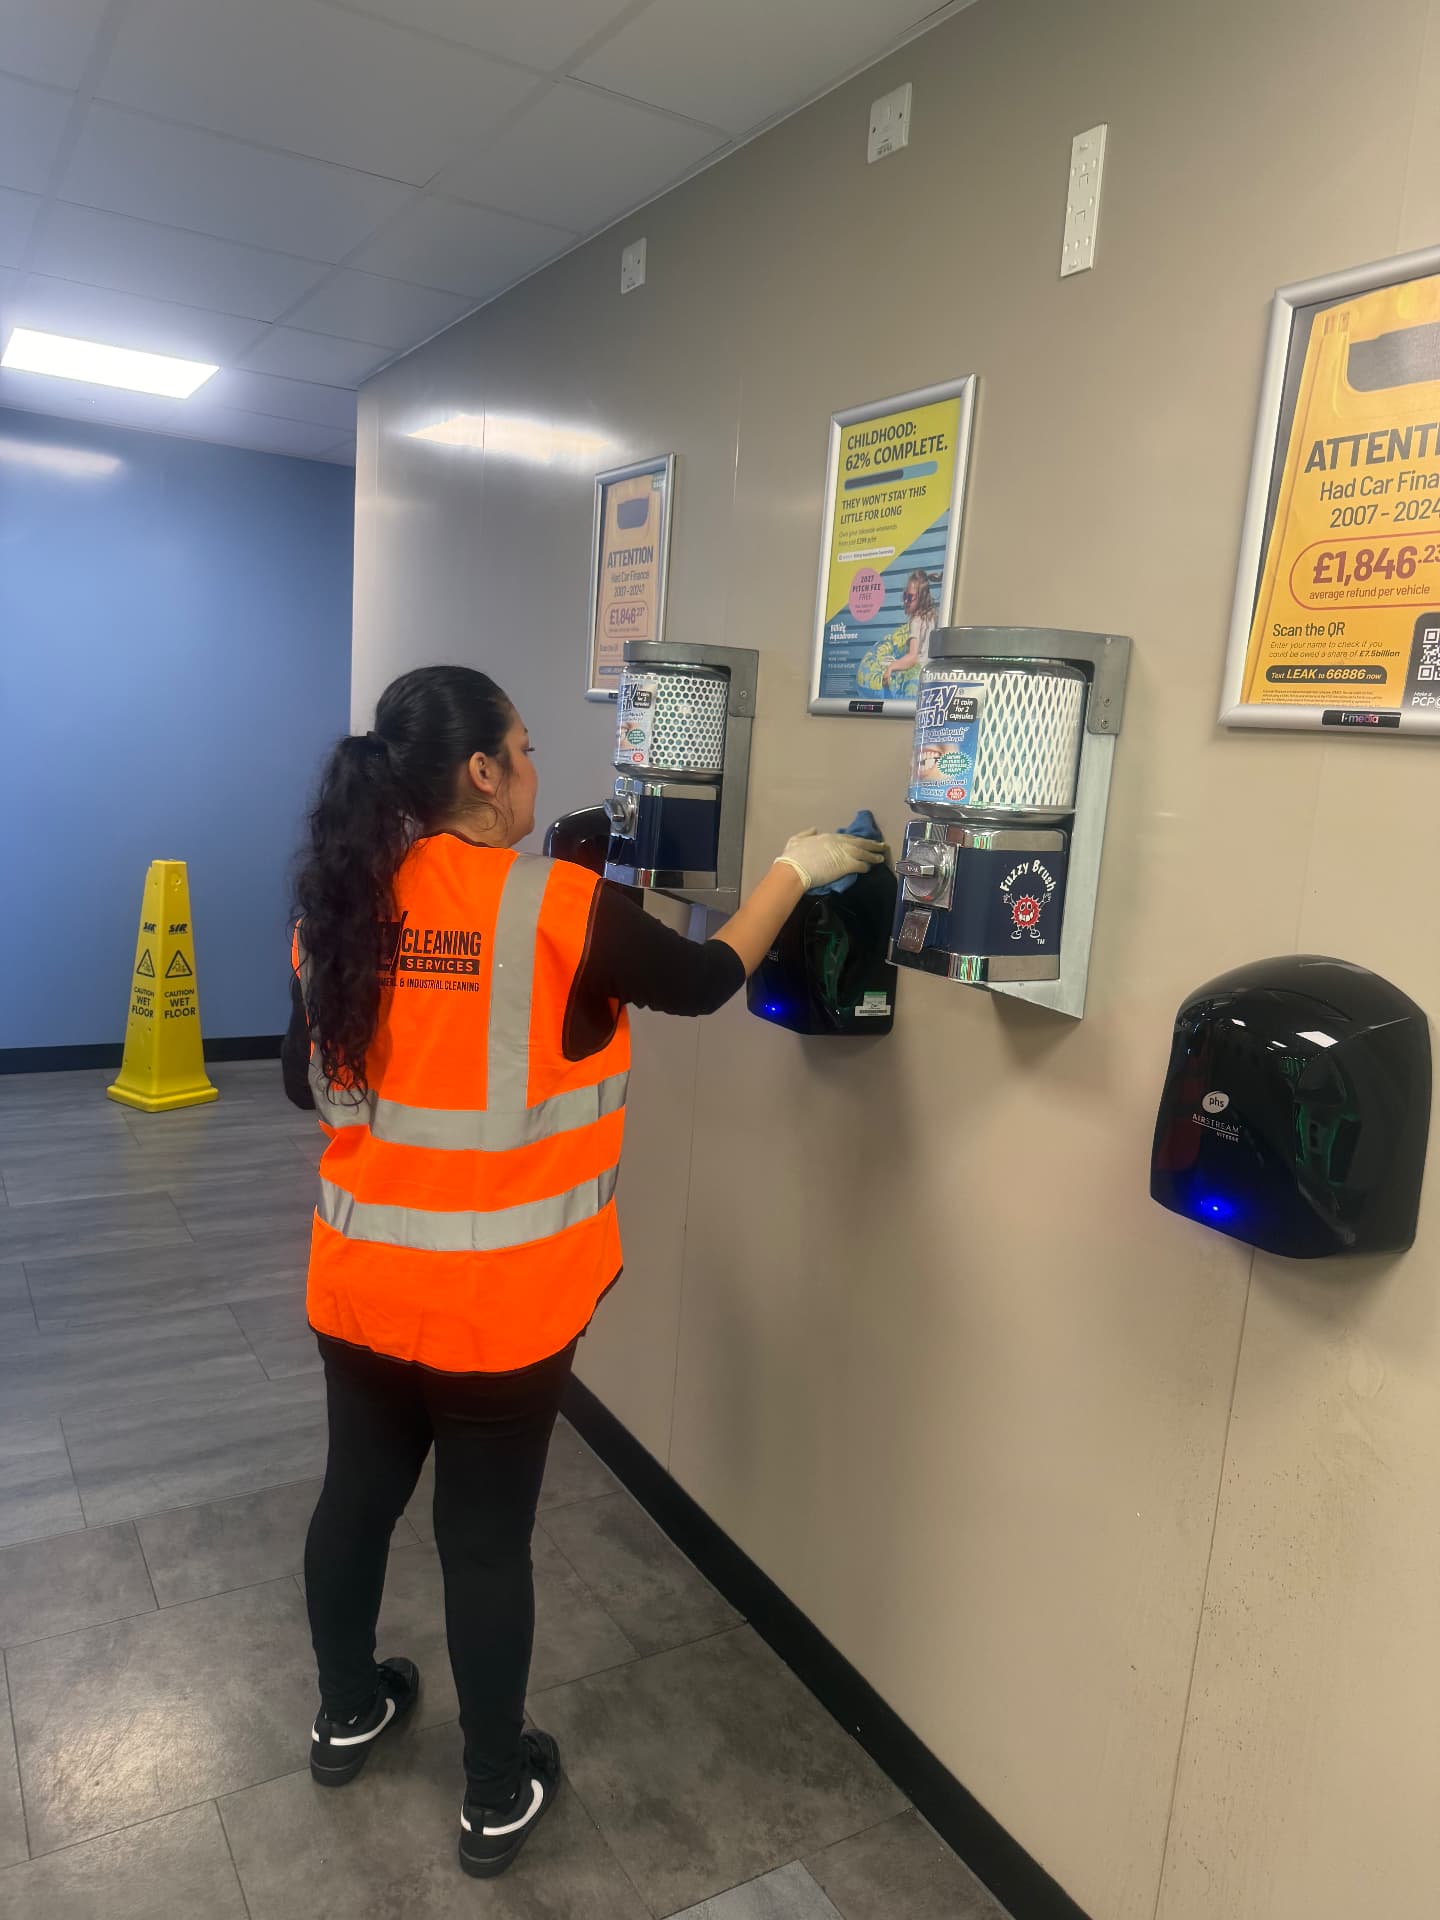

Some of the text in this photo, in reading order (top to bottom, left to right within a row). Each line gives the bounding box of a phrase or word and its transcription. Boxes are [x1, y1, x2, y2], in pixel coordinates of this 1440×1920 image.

[847, 421, 917, 450] CHILDHOOD:
[845, 434, 948, 471] 62% COMPLETE.
[1320, 470, 1440, 501] Had Car Fina
[842, 485, 927, 510] THEY WON'T STAY THIS
[840, 505, 902, 525] LITTLE FOR LONG
[607, 546, 654, 568] ATTENTION
[1309, 584, 1430, 600] average refund per vehicle
[1272, 622, 1346, 637] Scan the QR
[1270, 641, 1287, 649] Enter
[1337, 640, 1359, 648] check
[1368, 641, 1383, 649] you
[1349, 649, 1358, 657] of
[1286, 668, 1319, 679] LEAK
[1326, 668, 1367, 680] 66886
[949, 713, 974, 721] capsules
[1000, 859, 1057, 892] Fuzzy Brush
[401, 928, 482, 956] CLEANING
[406, 958, 474, 972] SERVICES
[134, 986, 155, 997] CAUTION
[407, 978, 443, 990] INDUSTRIAL
[444, 980, 480, 992] CLEANING
[164, 987, 195, 998] CAUTION
[137, 995, 151, 1006] WET
[170, 997, 190, 1007] WET
[131, 1005, 154, 1018] FLOOR
[164, 1007, 196, 1019] FLOOR
[1209, 1096, 1224, 1108] phs
[1192, 1113, 1240, 1133] AIRSTREAM
